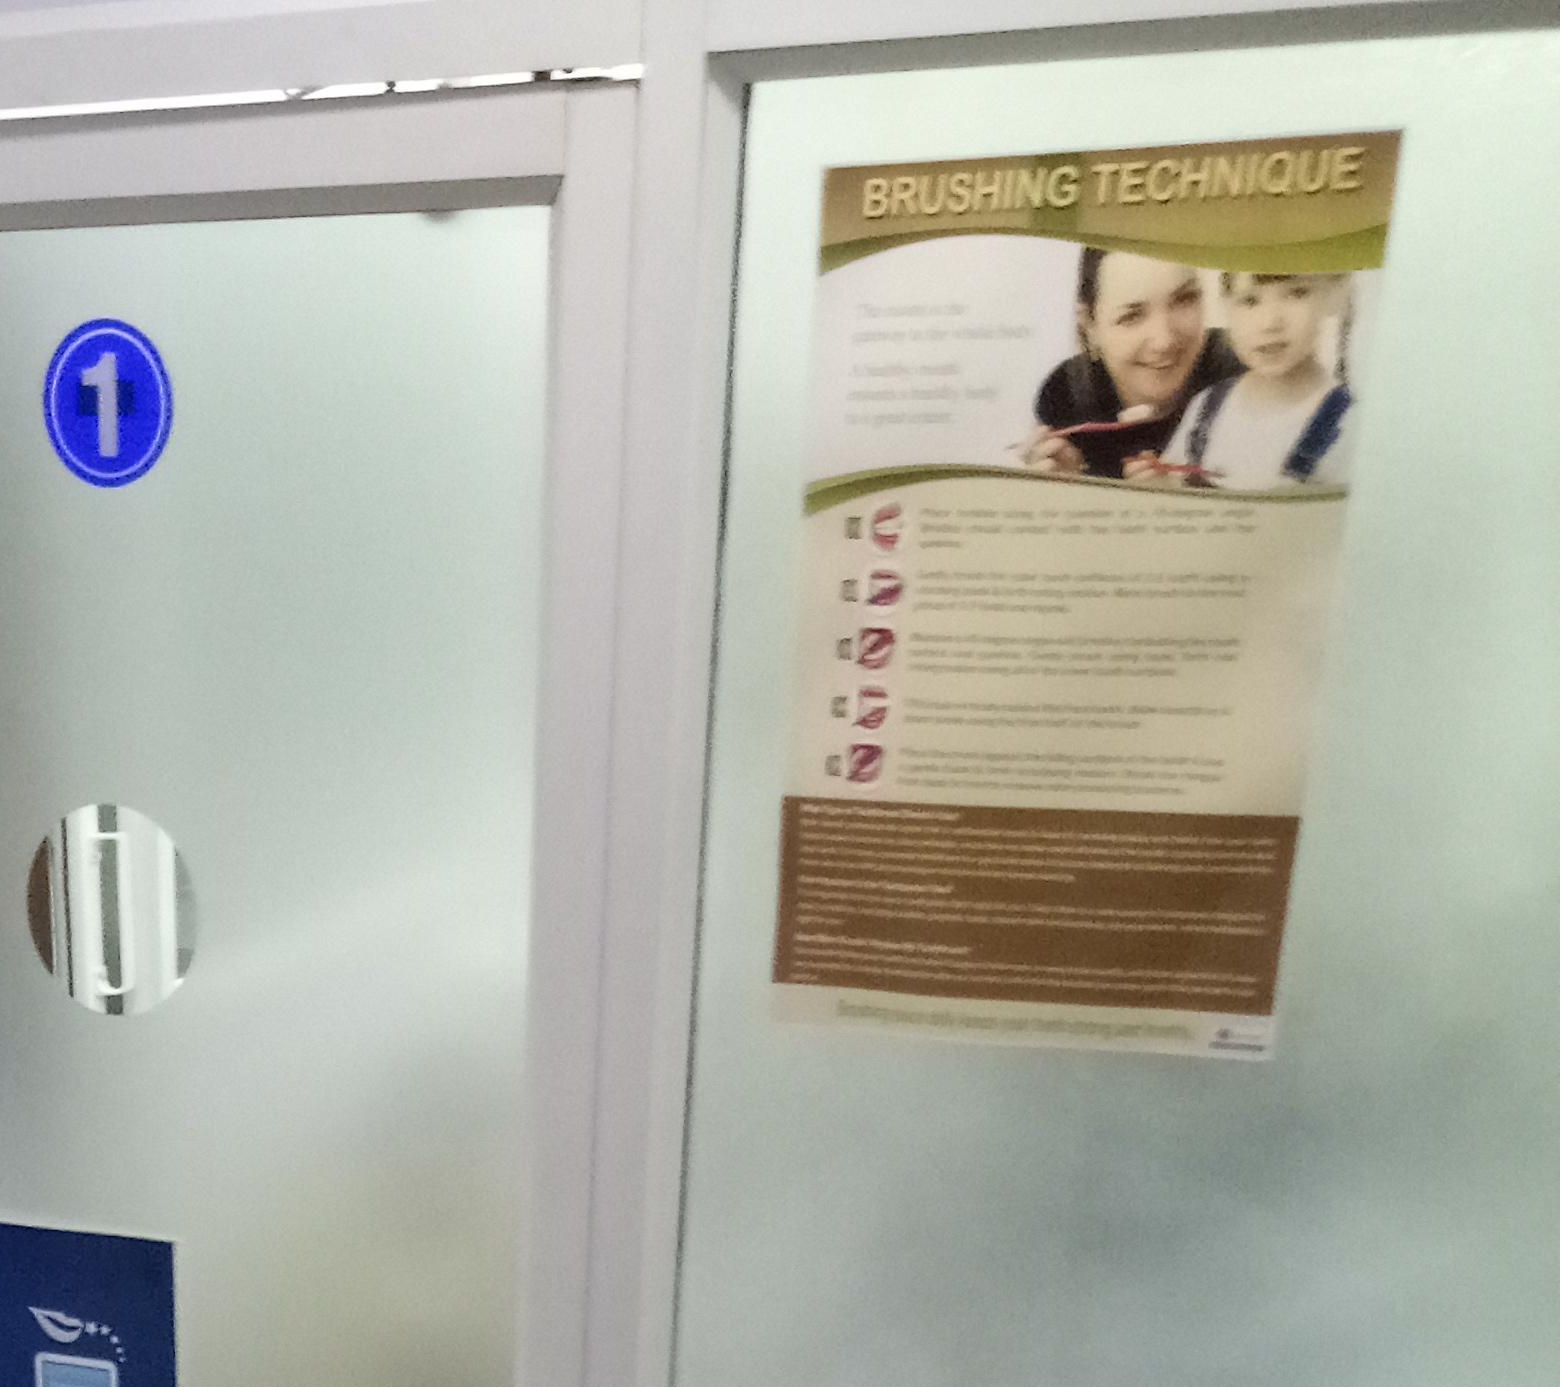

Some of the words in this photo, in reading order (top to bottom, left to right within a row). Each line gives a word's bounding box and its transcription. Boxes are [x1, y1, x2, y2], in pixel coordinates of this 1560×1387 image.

[862, 165, 1078, 219] BRUSHING
[1092, 146, 1365, 206] TECHNIQUE
[81, 352, 120, 458] 1
